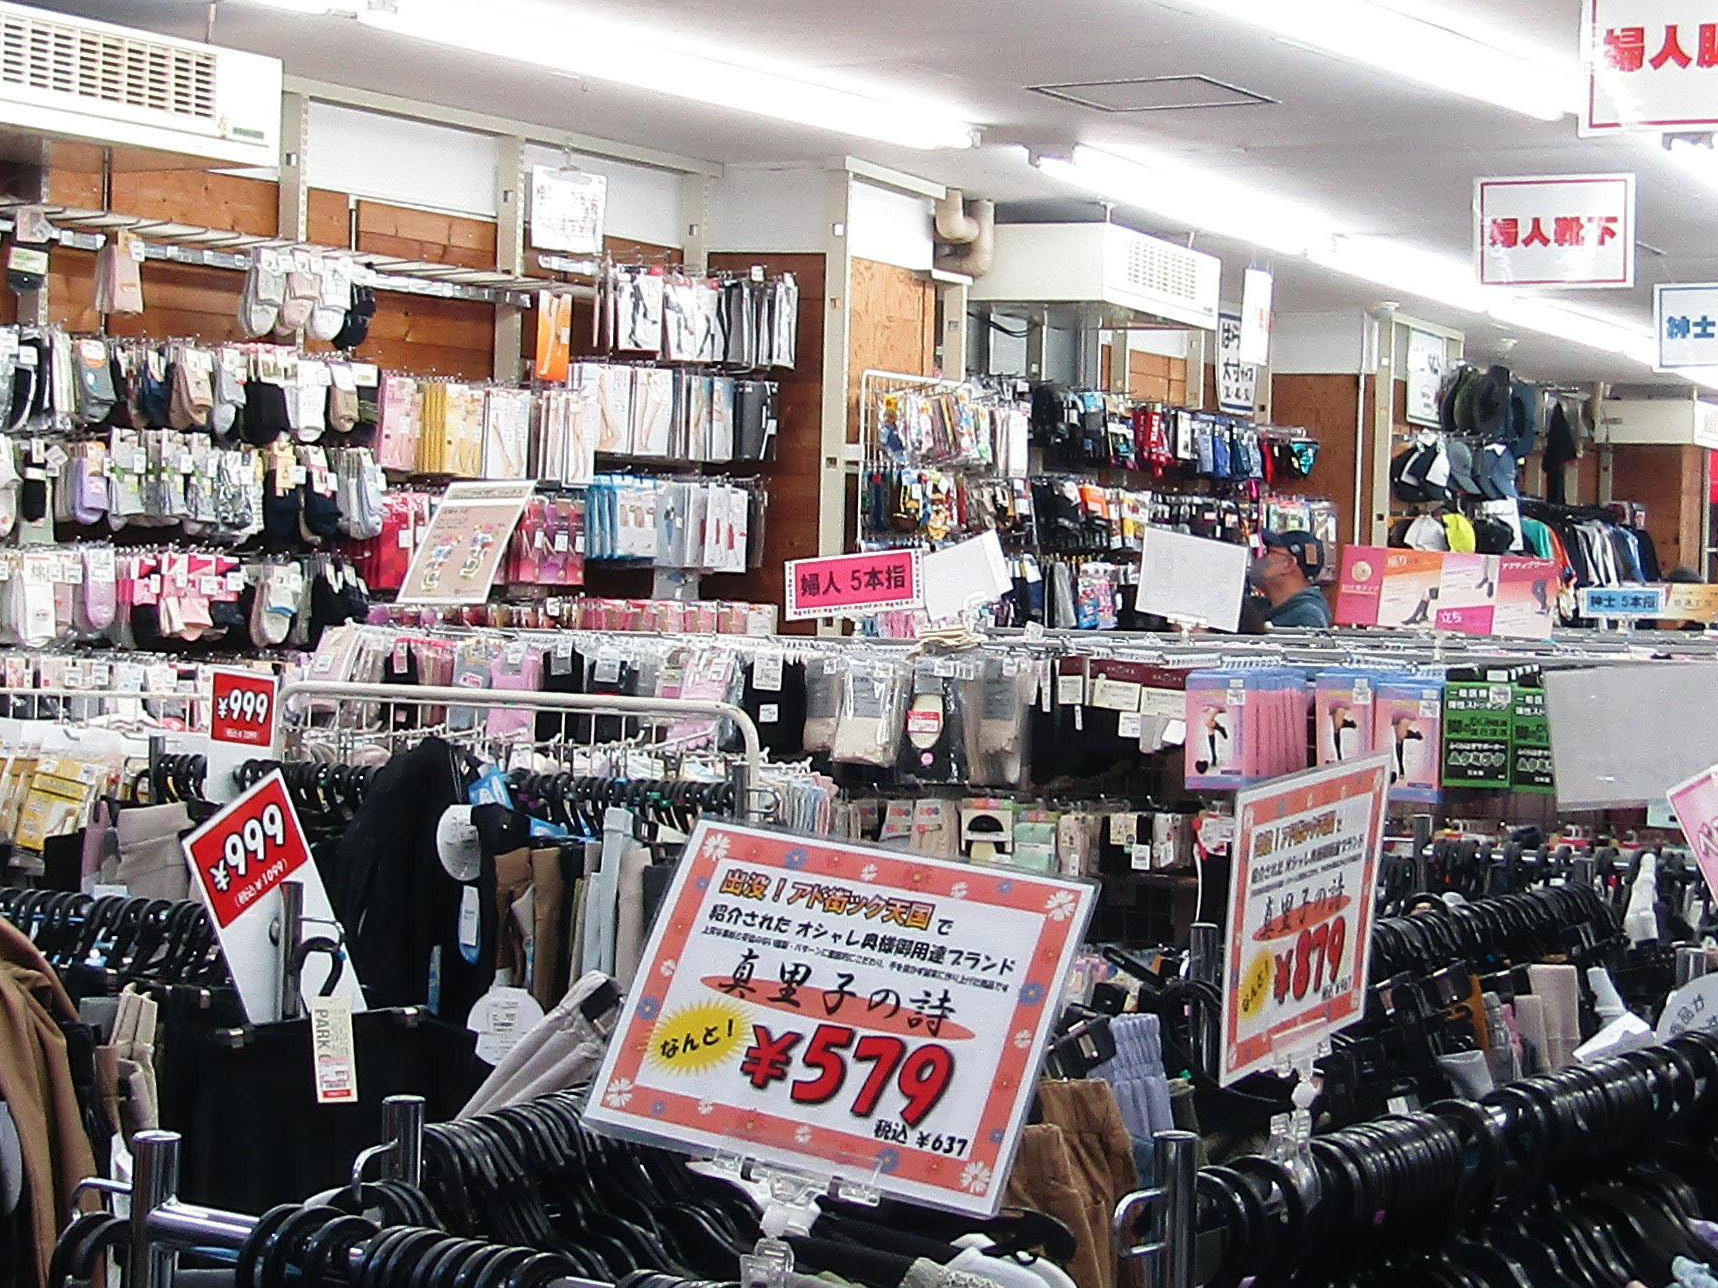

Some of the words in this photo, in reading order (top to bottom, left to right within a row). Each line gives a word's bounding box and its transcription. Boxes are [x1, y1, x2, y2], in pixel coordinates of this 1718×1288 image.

[1489, 216, 1618, 248] 婦人靴下
[800, 570, 842, 598] 婦人
[850, 564, 907, 591] 5本指
[217, 689, 269, 724] ¥999
[209, 802, 286, 892] ¥999
[707, 902, 793, 935] 紹介された
[796, 920, 1020, 977] オシャレ奥様御用達ブランド
[1273, 914, 1347, 1006] ¥879
[717, 947, 958, 1038] 真里子の詩
[314, 1008, 332, 1050] PARK
[740, 1023, 957, 1129] ¥579
[873, 1117, 910, 1145] 税込
[915, 1131, 969, 1157] ¥637
